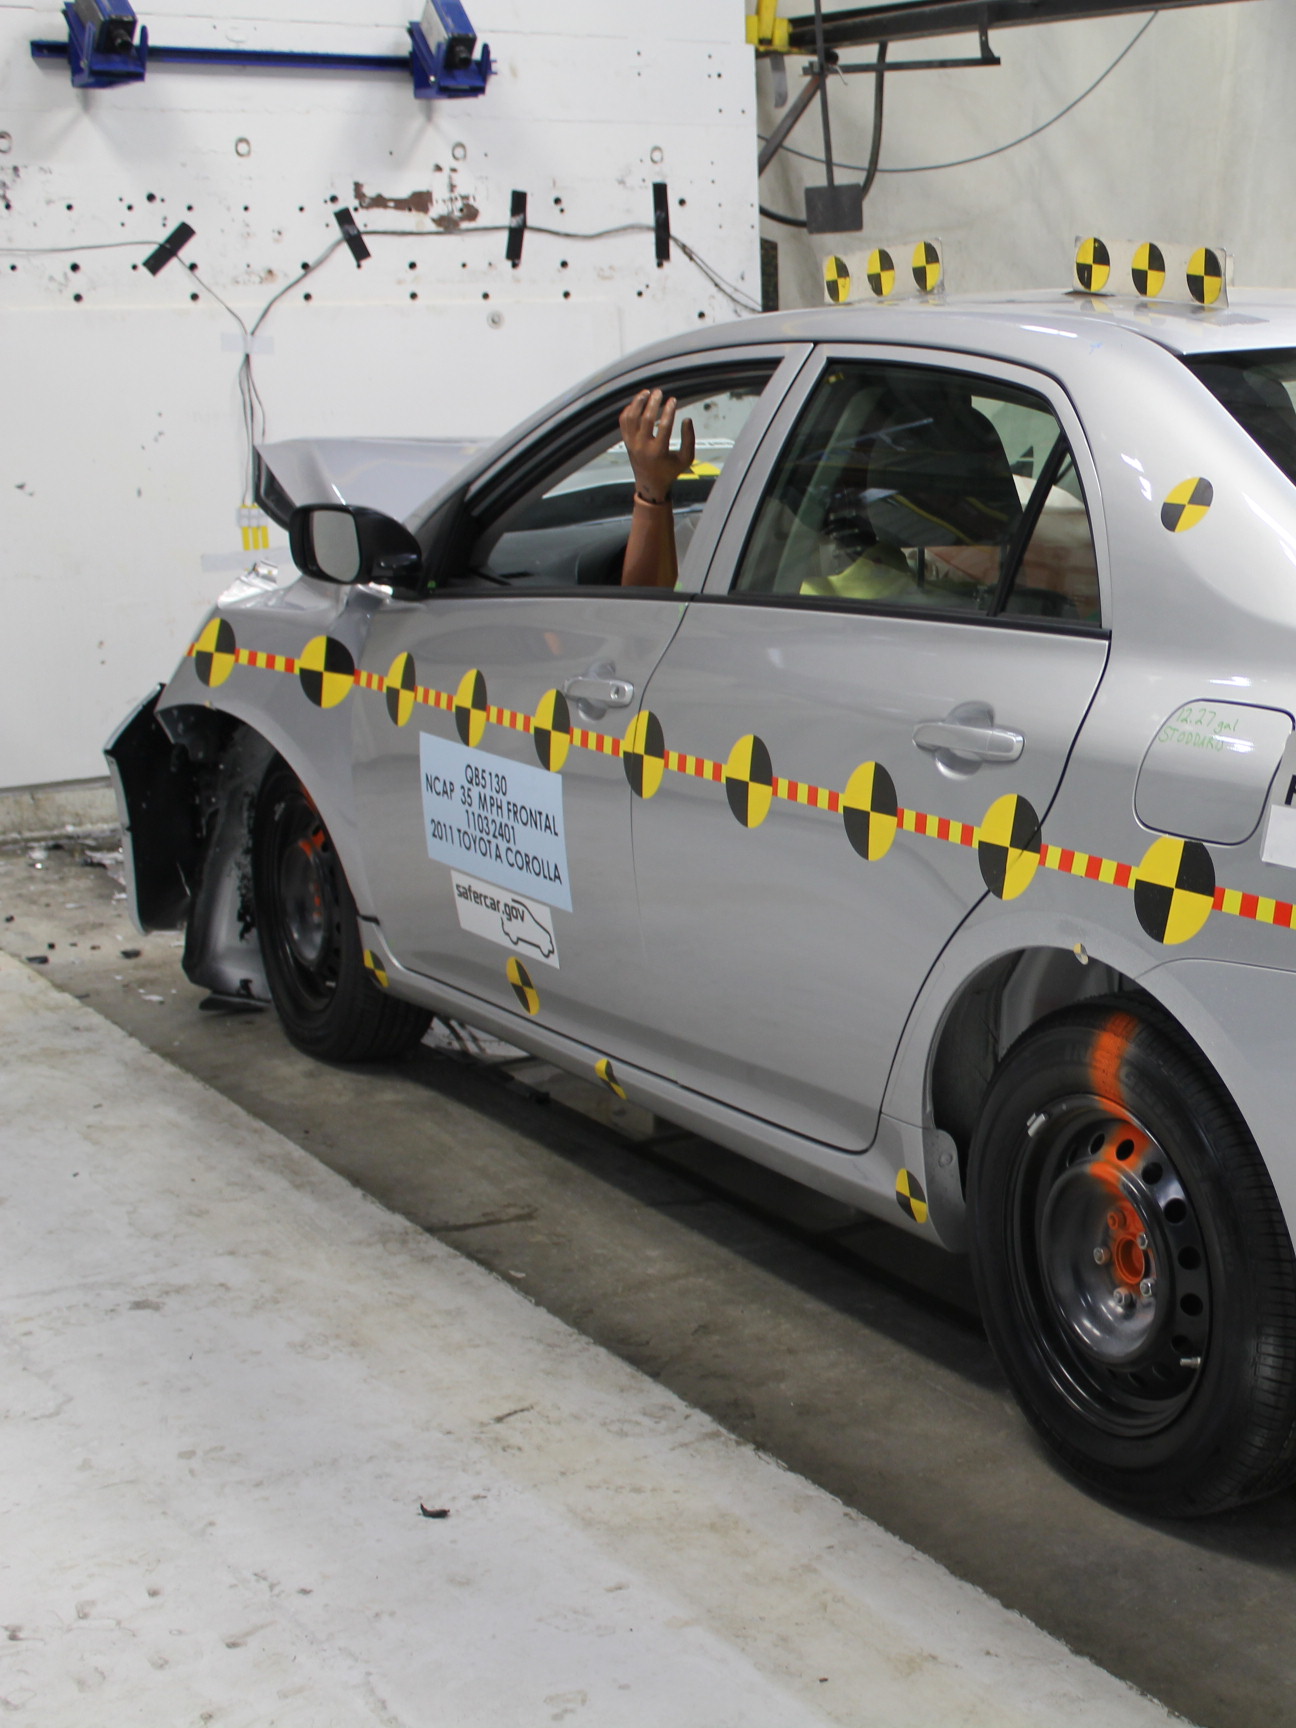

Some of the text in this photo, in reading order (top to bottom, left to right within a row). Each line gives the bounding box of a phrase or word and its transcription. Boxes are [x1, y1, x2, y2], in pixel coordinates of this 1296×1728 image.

[465, 764, 507, 796] QB5130
[425, 773, 559, 837] NCAP 35 MPH FRONTAL
[465, 810, 517, 845] 11032401
[430, 819, 562, 884] 2011 TOYOTA COROLLA
[456, 884, 525, 922] safercar.gov
